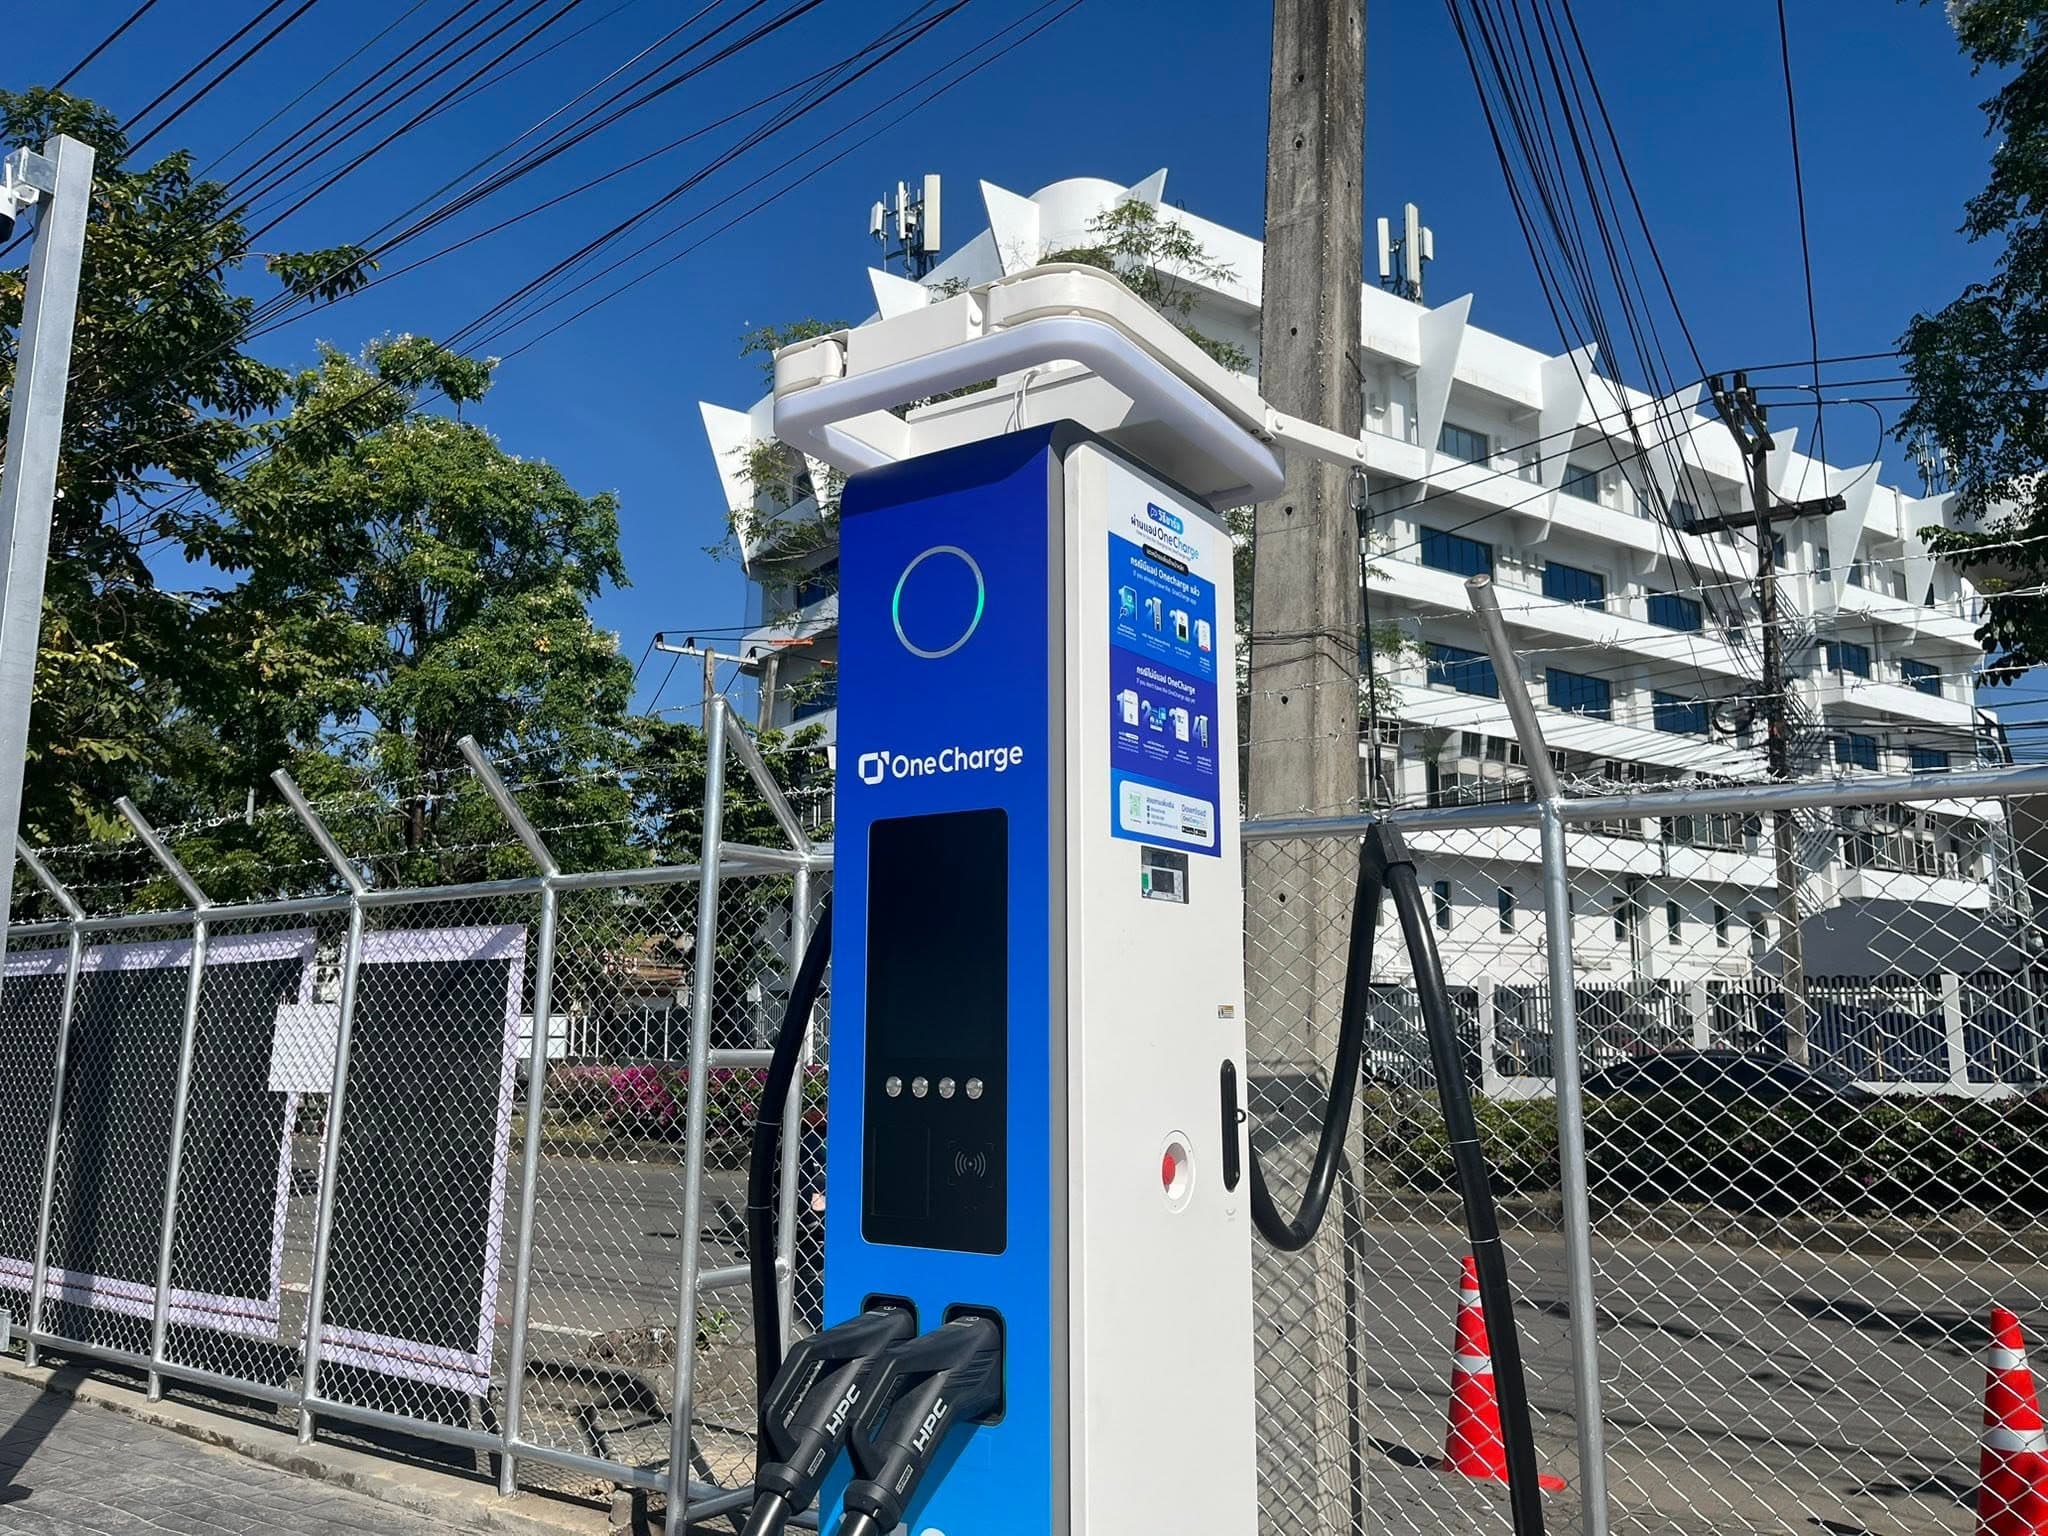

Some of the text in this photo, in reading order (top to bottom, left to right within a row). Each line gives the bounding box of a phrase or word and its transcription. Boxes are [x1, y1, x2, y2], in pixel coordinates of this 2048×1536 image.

[1158, 527, 1200, 560] OneCharge
[892, 746, 1023, 778] OneCharge
[1181, 804, 1207, 817] Download
[825, 1383, 862, 1437] HPC
[912, 1398, 948, 1452] HPC
